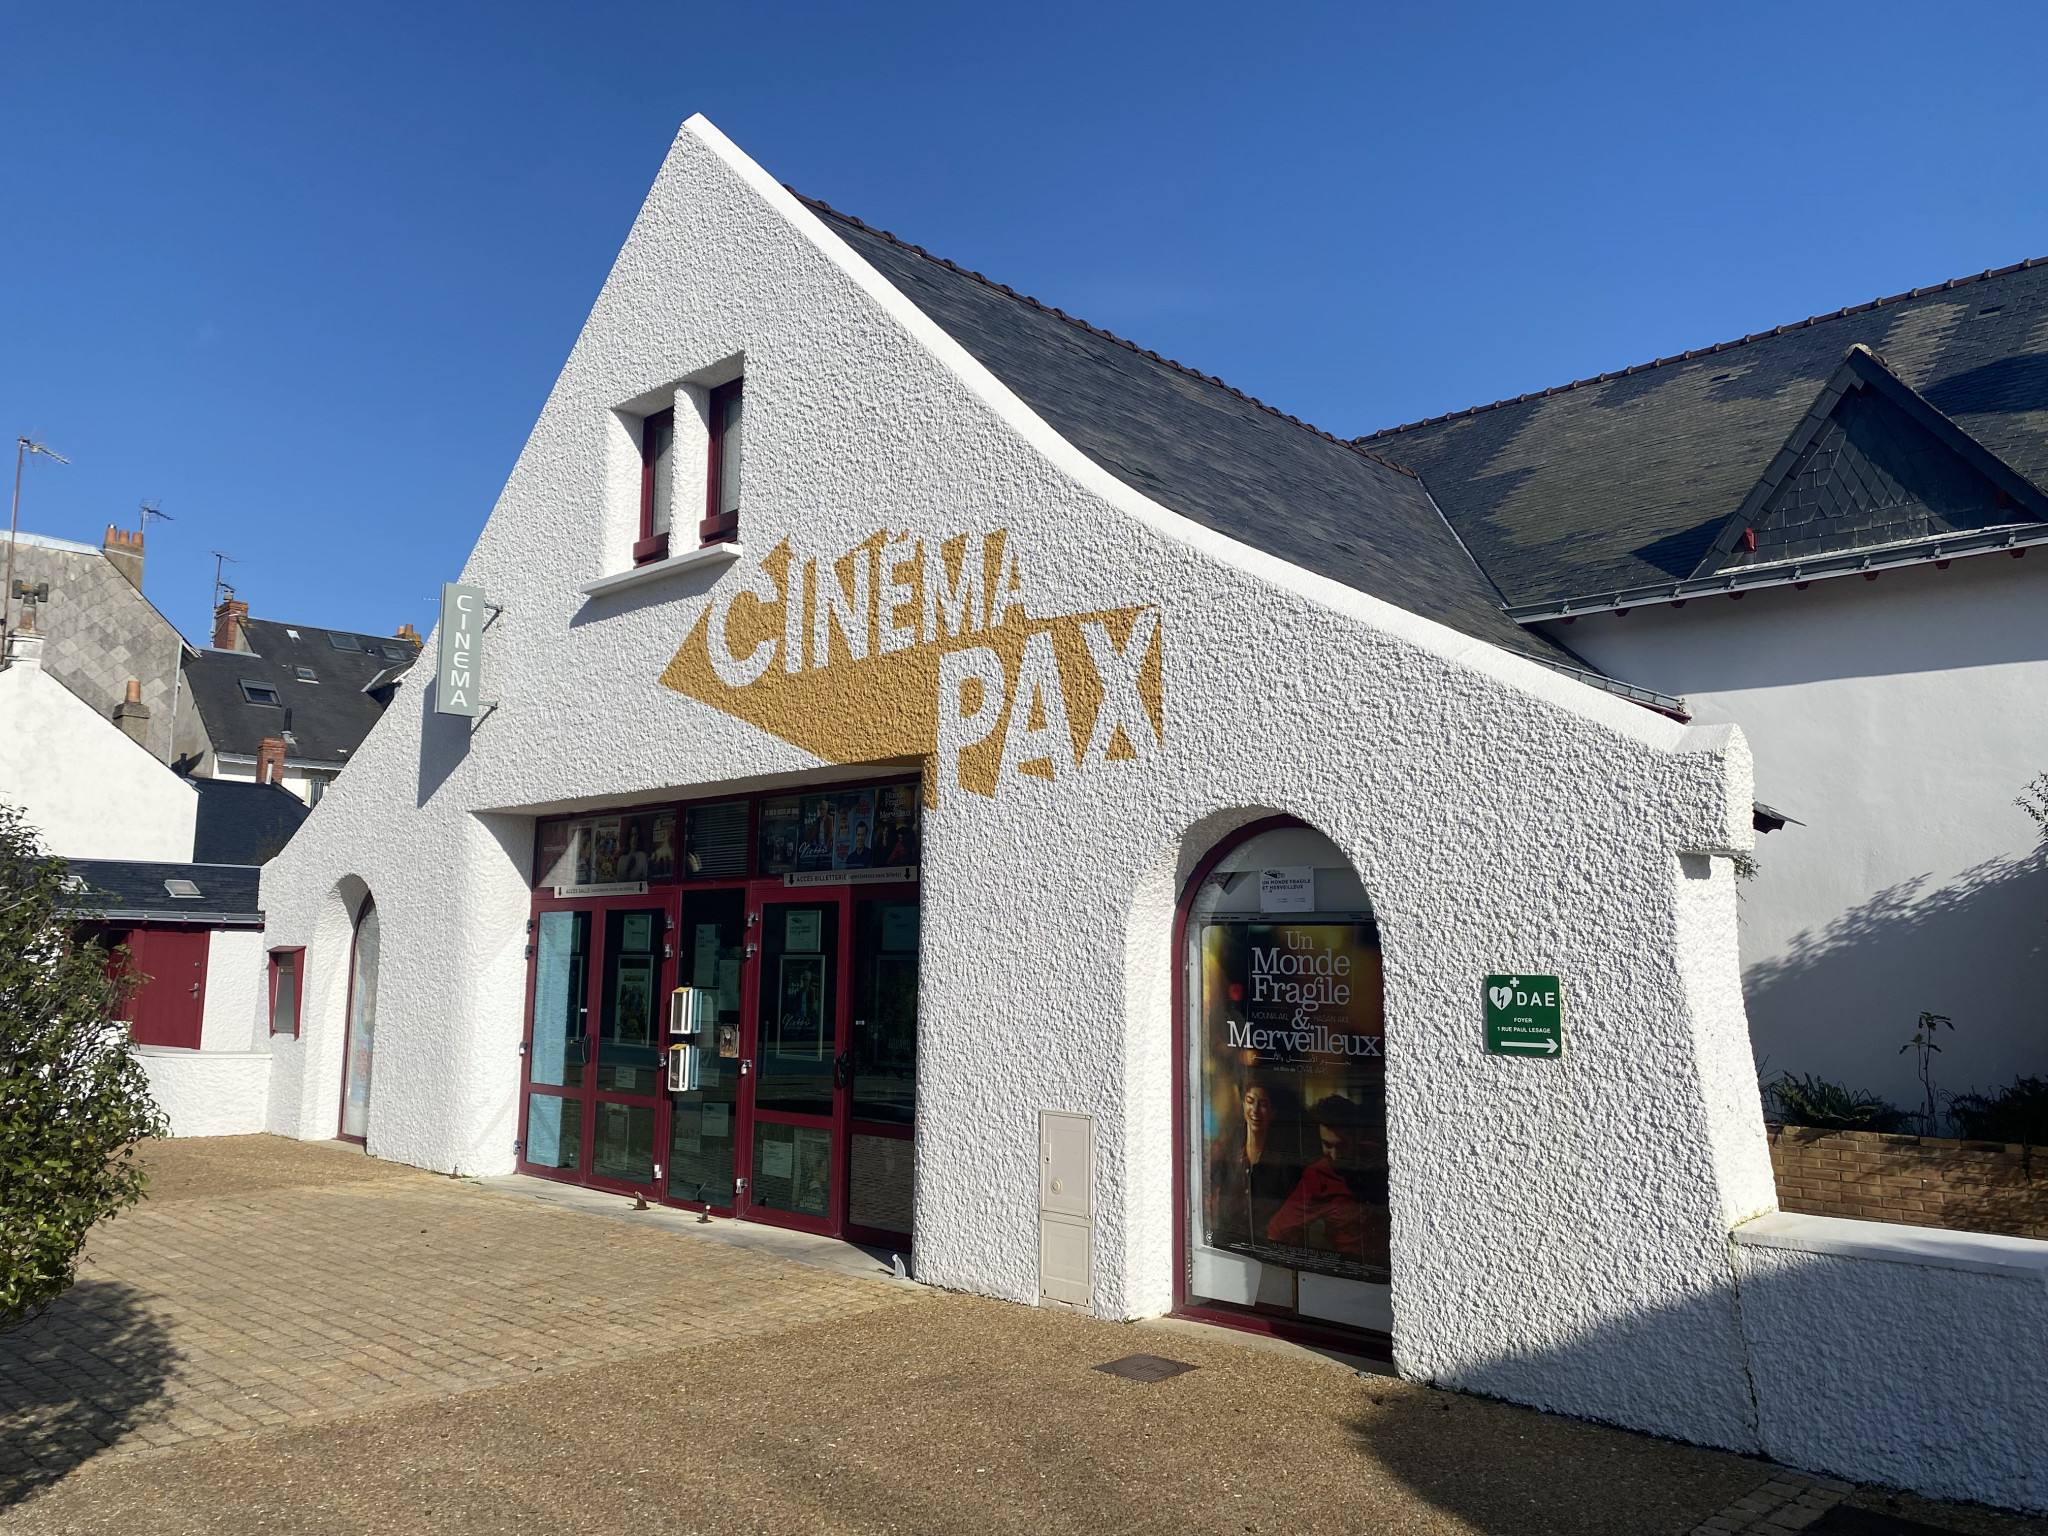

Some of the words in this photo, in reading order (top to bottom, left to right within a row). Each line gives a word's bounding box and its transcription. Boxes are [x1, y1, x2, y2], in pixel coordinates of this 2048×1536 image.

[706, 531, 1032, 687] CINÉMA
[449, 594, 473, 708] CINEMA
[937, 607, 1166, 803] PAX
[814, 873, 847, 882] BILLETTERIE
[1285, 931, 1314, 950] Un
[1252, 947, 1350, 976] Monde
[1252, 974, 1350, 1011] Fragile
[1516, 991, 1556, 1007] DAE
[1291, 1008, 1310, 1030] &
[1227, 1021, 1382, 1057] Merveilleux
